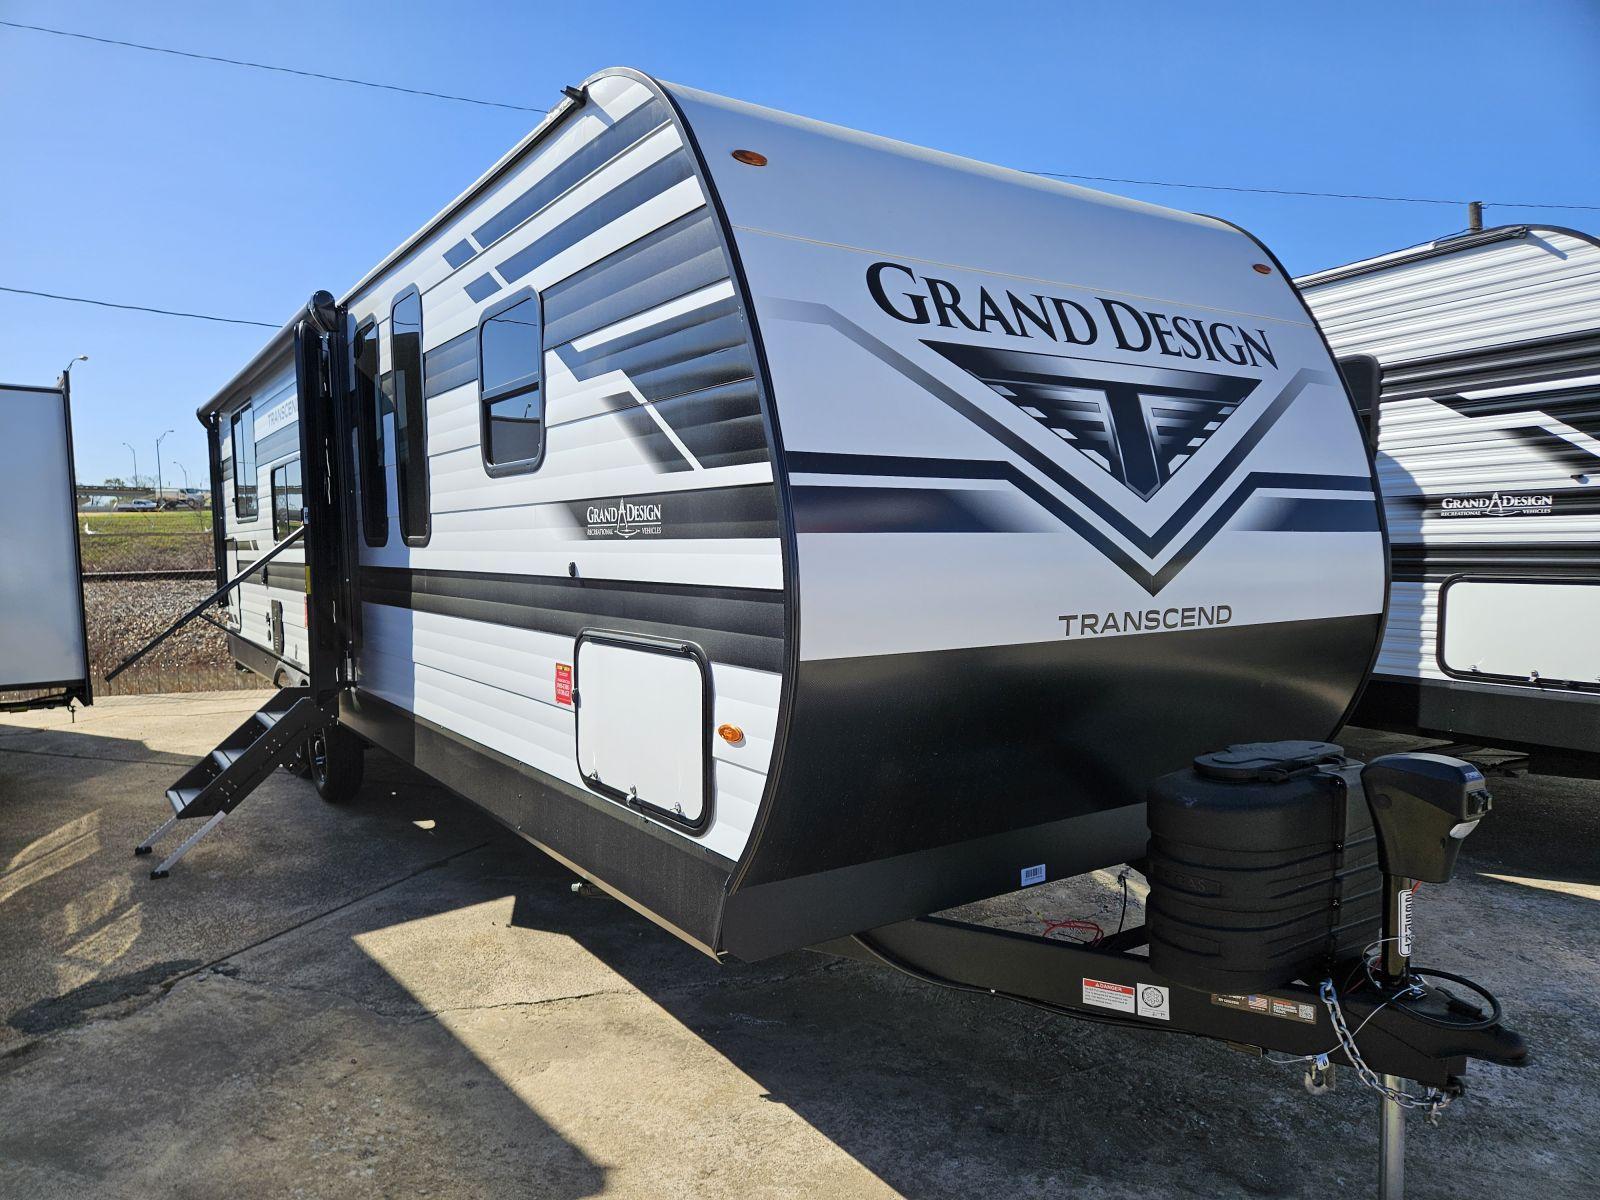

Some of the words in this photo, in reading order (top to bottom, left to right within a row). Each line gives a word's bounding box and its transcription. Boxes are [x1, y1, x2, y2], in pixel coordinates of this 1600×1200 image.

[866, 261, 1098, 346] GRAND
[1095, 296, 1279, 371] DESIGN
[586, 506, 618, 523] GRAND
[626, 504, 662, 521] DESIGN
[1441, 498, 1488, 509] GRAND
[1502, 495, 1552, 507] DESIGN
[1059, 604, 1233, 639] TRANSCEND
